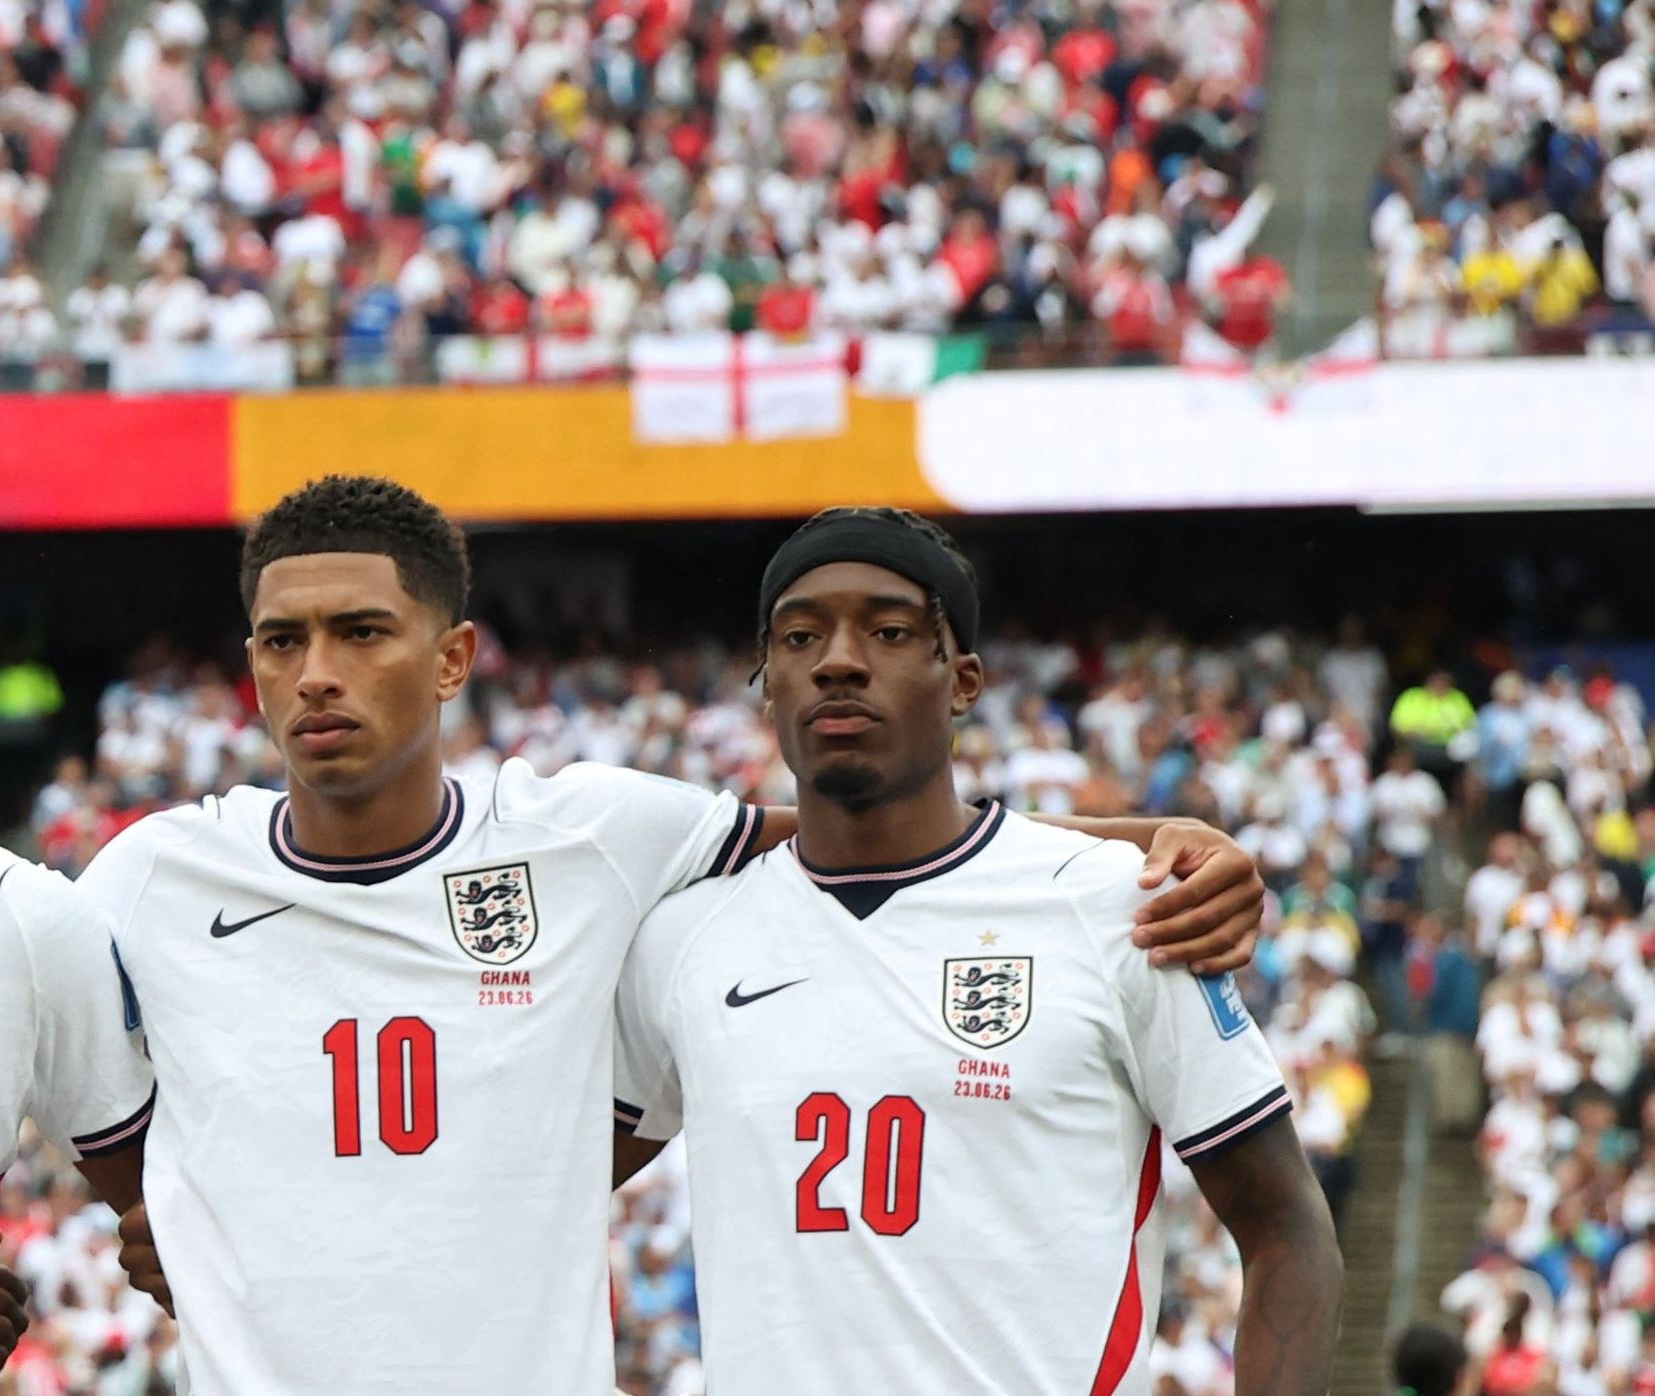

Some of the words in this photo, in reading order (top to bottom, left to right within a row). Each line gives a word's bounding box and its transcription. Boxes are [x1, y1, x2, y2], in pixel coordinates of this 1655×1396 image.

[481, 970, 531, 986] GHANA
[957, 1058, 1011, 1079] GHANA
[322, 1015, 440, 1157] 10
[953, 1080, 1012, 1101] 23.06.26
[795, 1091, 926, 1237] 20
